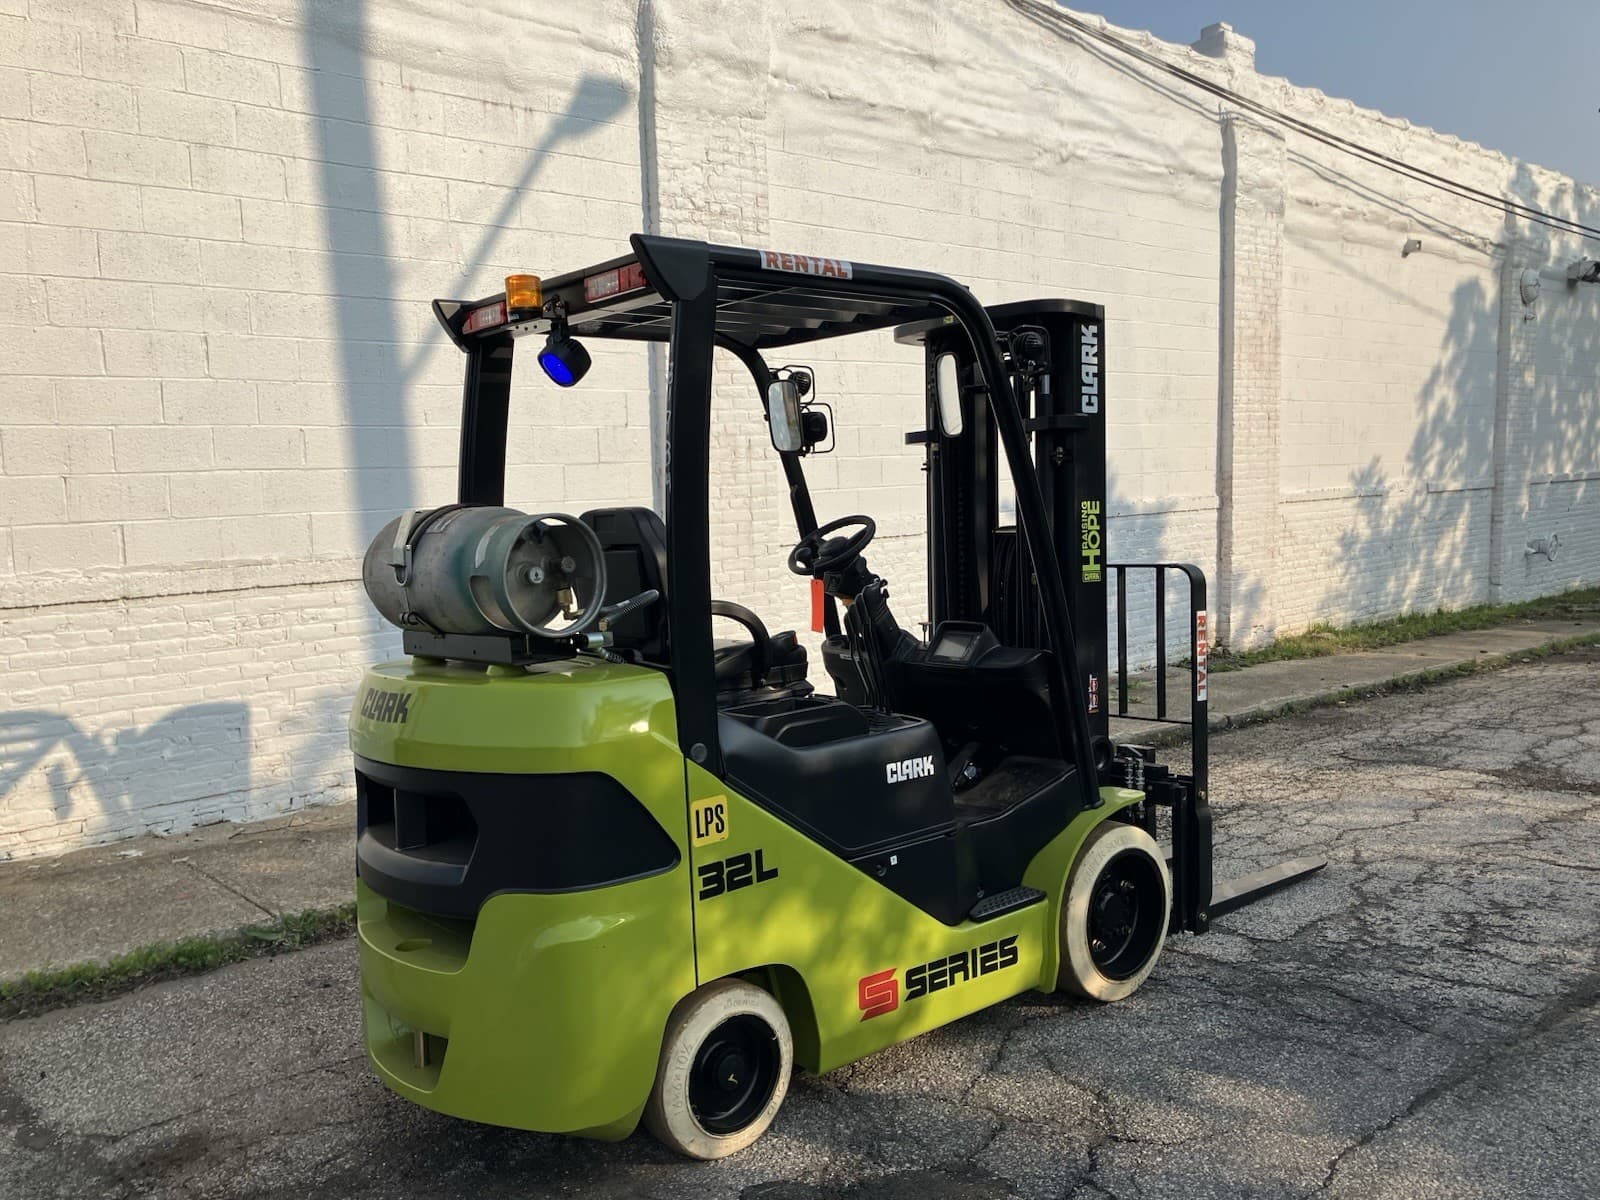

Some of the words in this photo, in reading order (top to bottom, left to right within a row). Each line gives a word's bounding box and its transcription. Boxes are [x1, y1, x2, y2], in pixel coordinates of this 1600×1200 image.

[765, 251, 848, 278] RENTAL
[1081, 324, 1098, 414] CLARK
[1082, 501, 1100, 572] HOPE
[1197, 615, 1206, 697] RENTAL
[361, 688, 412, 723] CLARK
[886, 755, 934, 784] CLARK
[695, 804, 725, 838] LPS
[698, 849, 778, 901] 32L
[859, 968, 898, 1022] S
[904, 935, 1019, 1001] SERIES
